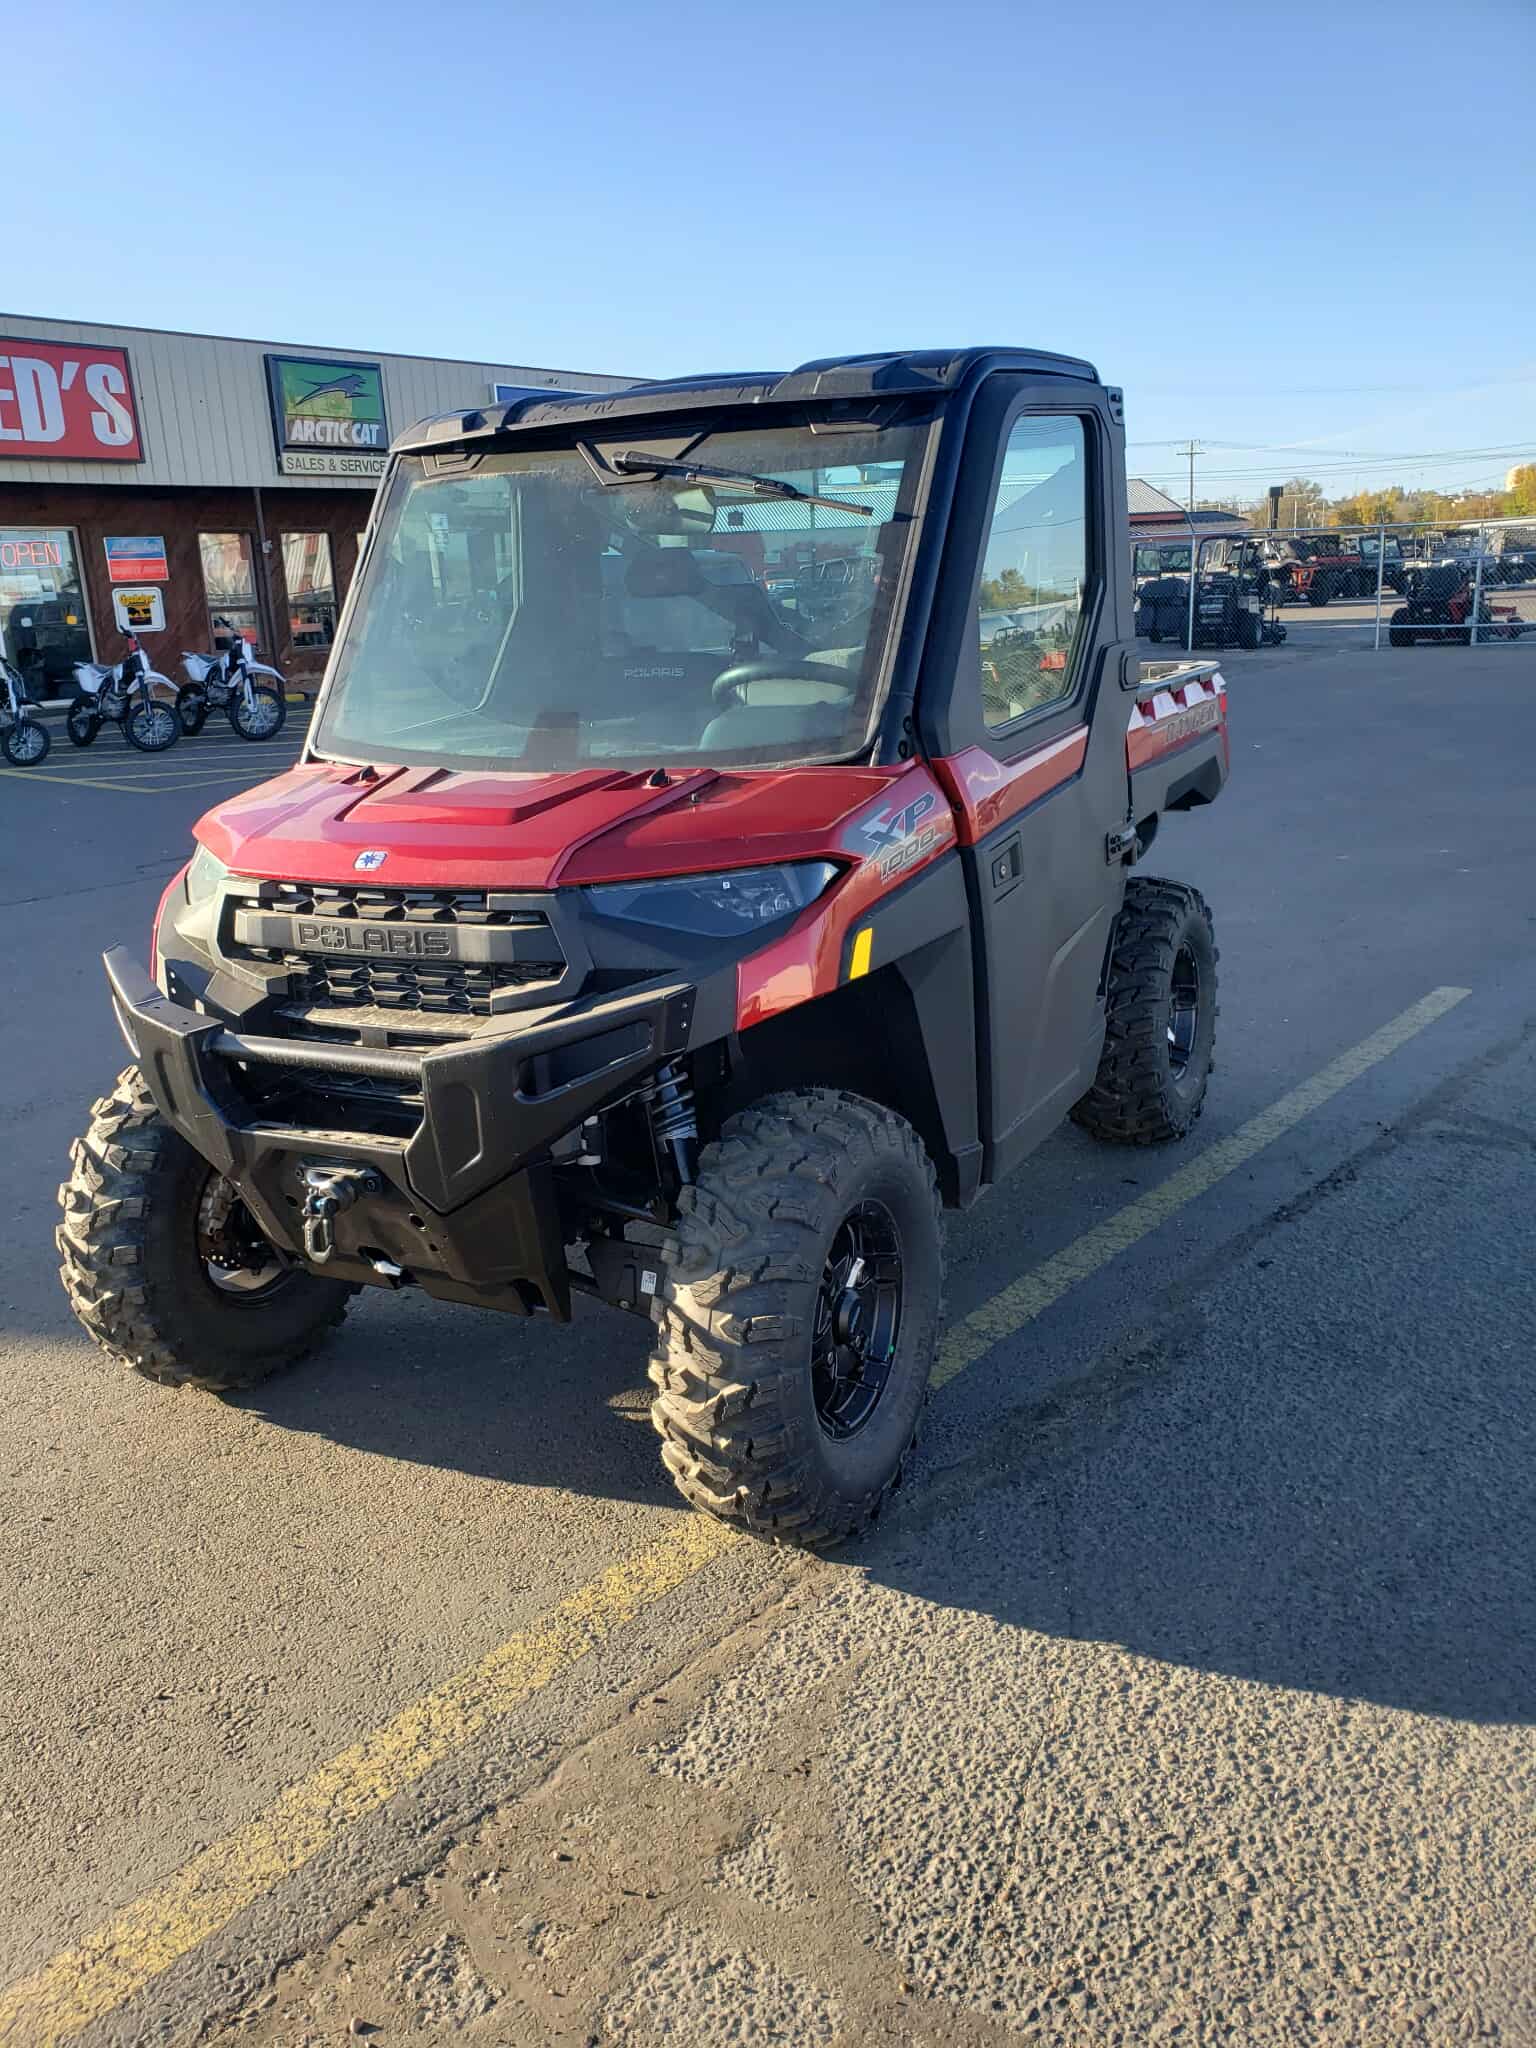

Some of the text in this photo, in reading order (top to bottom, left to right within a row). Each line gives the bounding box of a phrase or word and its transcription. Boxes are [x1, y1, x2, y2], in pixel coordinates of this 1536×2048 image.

[290, 419, 379, 445] ARCTIC CAT
[286, 457, 386, 473] SALES & SERVICE
[1, 541, 61, 567] OPEN
[623, 664, 686, 680] POLARIS
[861, 791, 936, 866] XP
[880, 823, 937, 880] 1000
[298, 922, 451, 956] POLARIS
